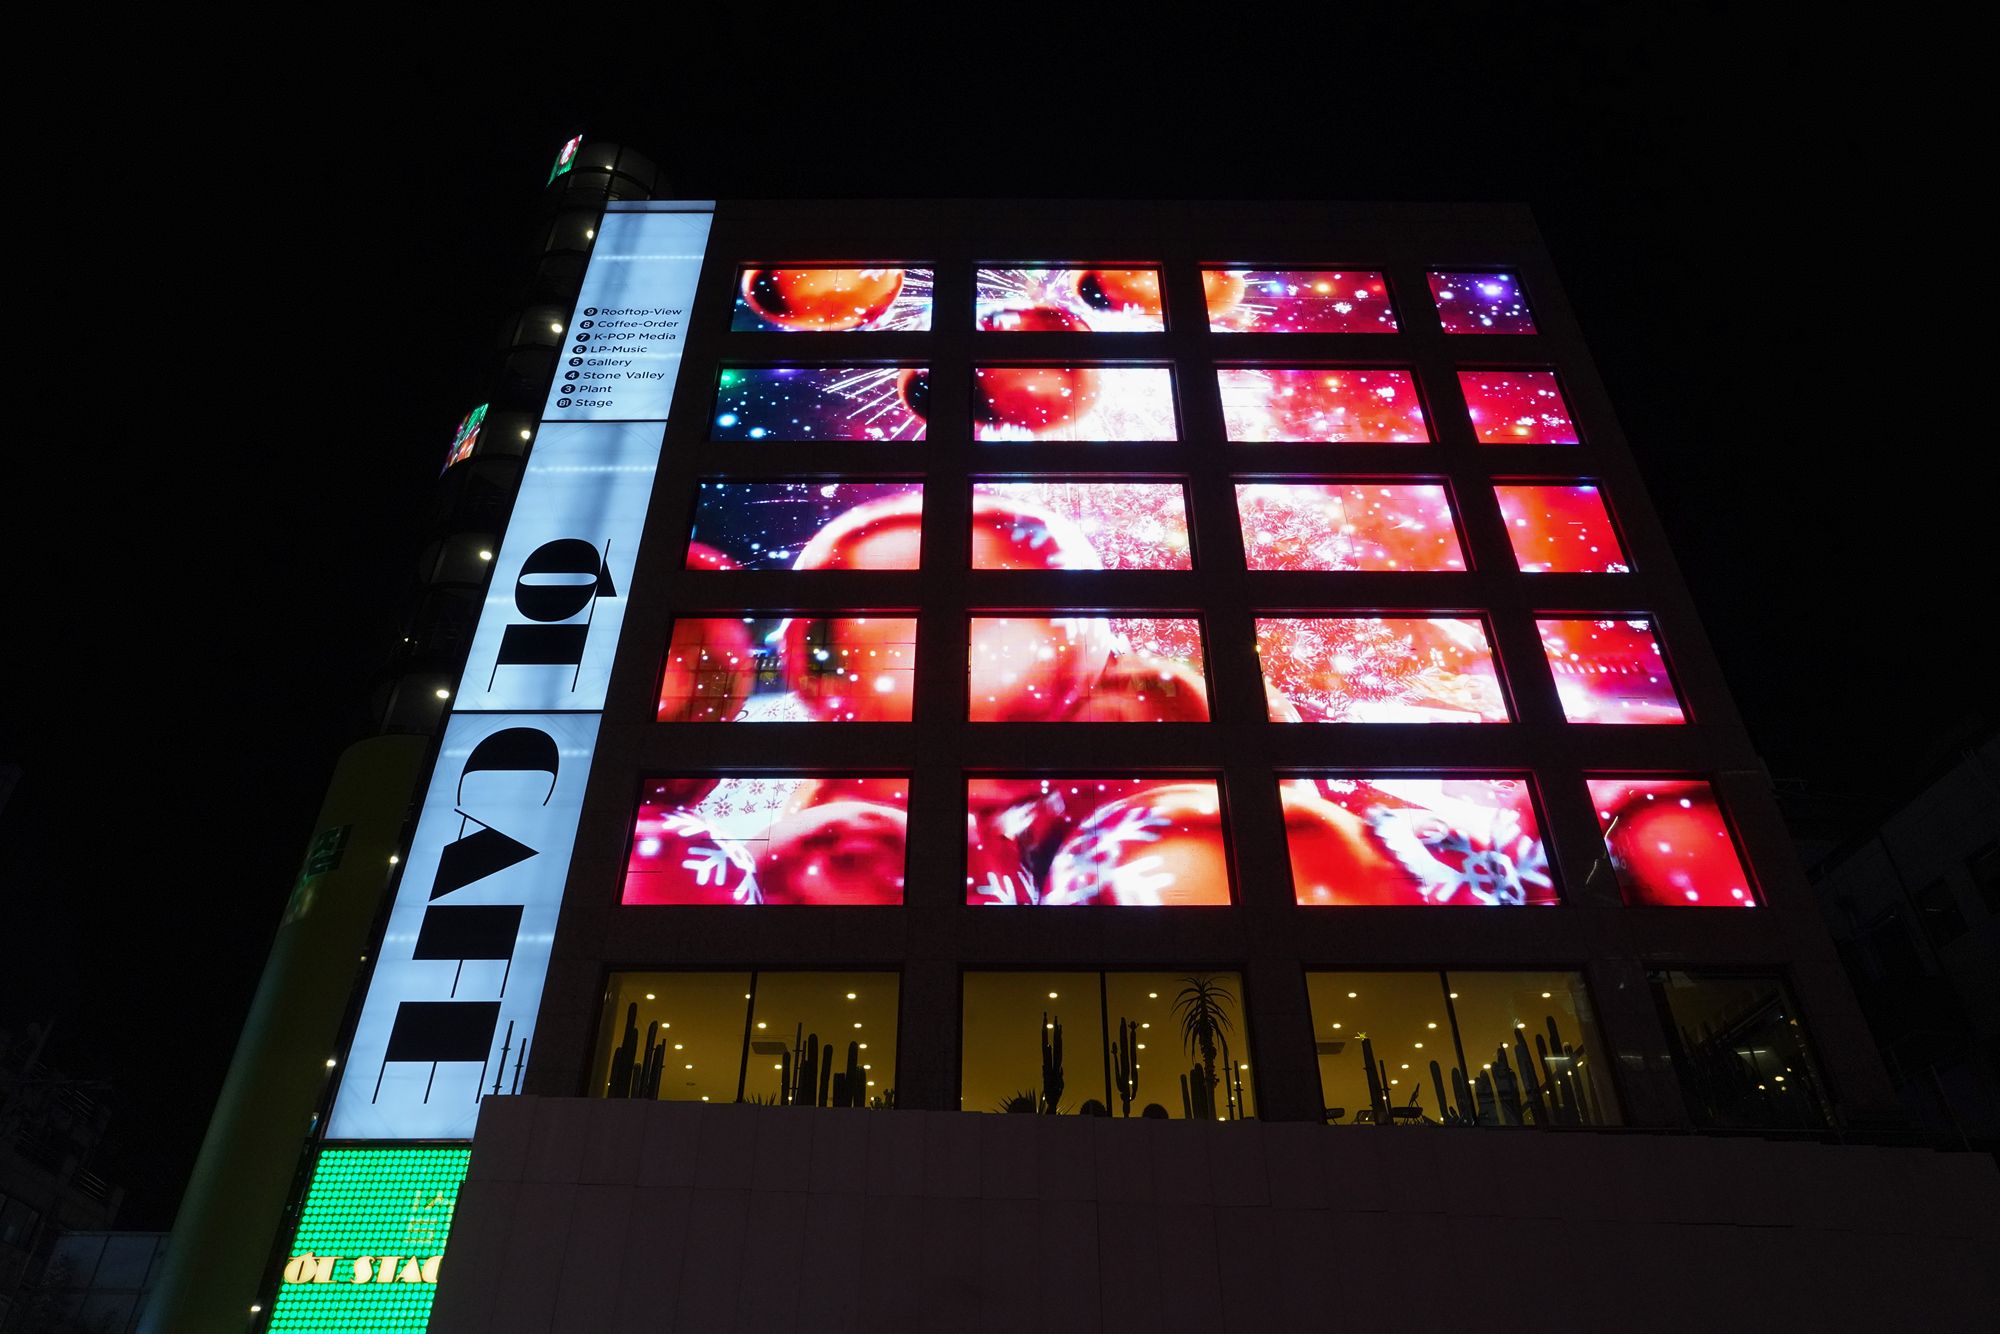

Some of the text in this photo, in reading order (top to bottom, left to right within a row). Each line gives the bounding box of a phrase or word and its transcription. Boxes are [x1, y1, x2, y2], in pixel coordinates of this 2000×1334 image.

[601, 308, 682, 316] Rooftop-View
[598, 320, 679, 328] Coffee-Order
[638, 332, 676, 340] Media
[590, 345, 648, 353] LP-Music
[587, 358, 632, 367] Gallery
[583, 371, 621, 380] Stone
[626, 371, 665, 380] Valley
[579, 385, 612, 393] Plant
[575, 399, 613, 408] Stage
[371, 727, 560, 1105] CAFE
